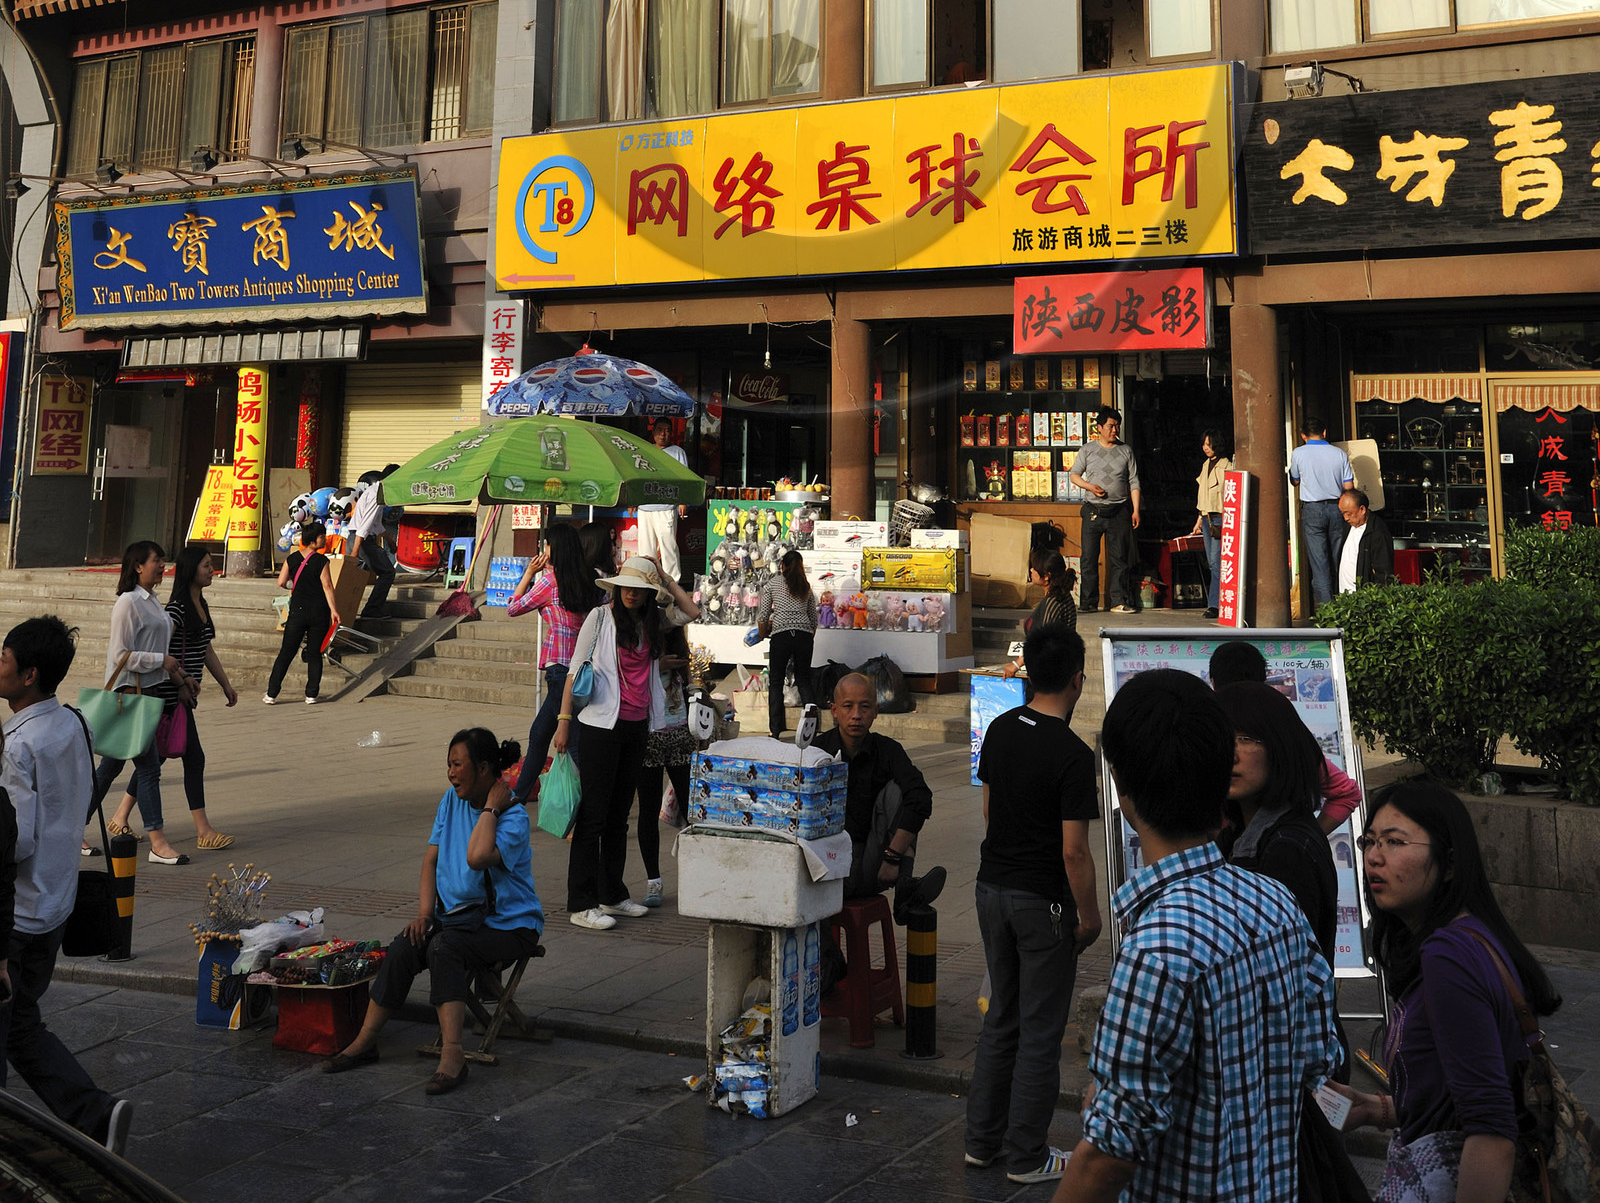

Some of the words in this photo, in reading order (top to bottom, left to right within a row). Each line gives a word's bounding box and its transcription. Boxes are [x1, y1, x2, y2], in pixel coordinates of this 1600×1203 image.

[637, 129, 694, 150] 方正科技
[626, 118, 1211, 239] 网络桌球会所
[1281, 101, 1600, 220] 大成青
[533, 181, 575, 233] T8
[1012, 219, 1189, 252] 旅游商城二三楼
[92, 286, 122, 305] Xi'an
[122, 283, 168, 303] WenBao
[170, 282, 195, 301] Two
[197, 280, 240, 300] Towers
[242, 277, 294, 301] Antiques
[296, 271, 355, 298] Shopping
[357, 270, 400, 290] Center
[1022, 285, 1200, 341] 陕西皮影
[500, 403, 532, 413] PEPSI
[561, 402, 609, 413] 百事可乐
[645, 403, 681, 414] PEPSI
[39, 409, 84, 456] 网络
[207, 470, 223, 489] T8
[201, 493, 226, 539] 正常营业
[1221, 479, 1236, 584] 陕西皮影
